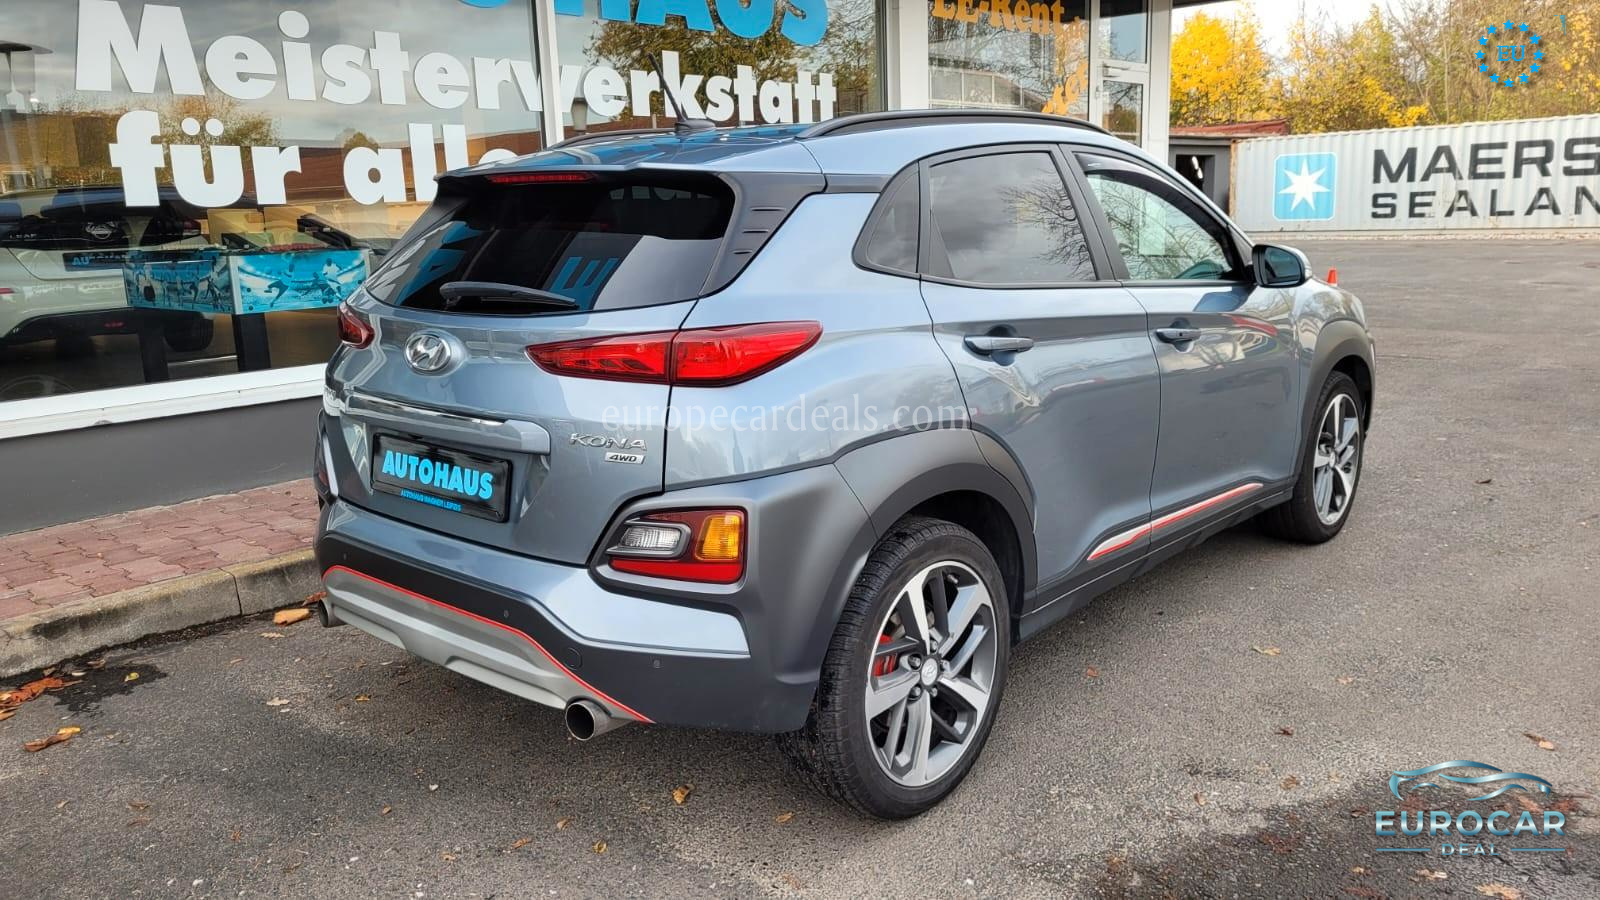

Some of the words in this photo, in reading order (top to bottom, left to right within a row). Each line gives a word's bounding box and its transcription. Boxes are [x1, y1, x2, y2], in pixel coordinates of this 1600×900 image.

[76, 0, 836, 124] Meisterwerkstatt
[109, 110, 301, 207] für
[343, 123, 520, 205] all
[569, 432, 647, 451] KONA
[609, 454, 637, 462] 4WD
[382, 450, 493, 499] AUTOHAUS
